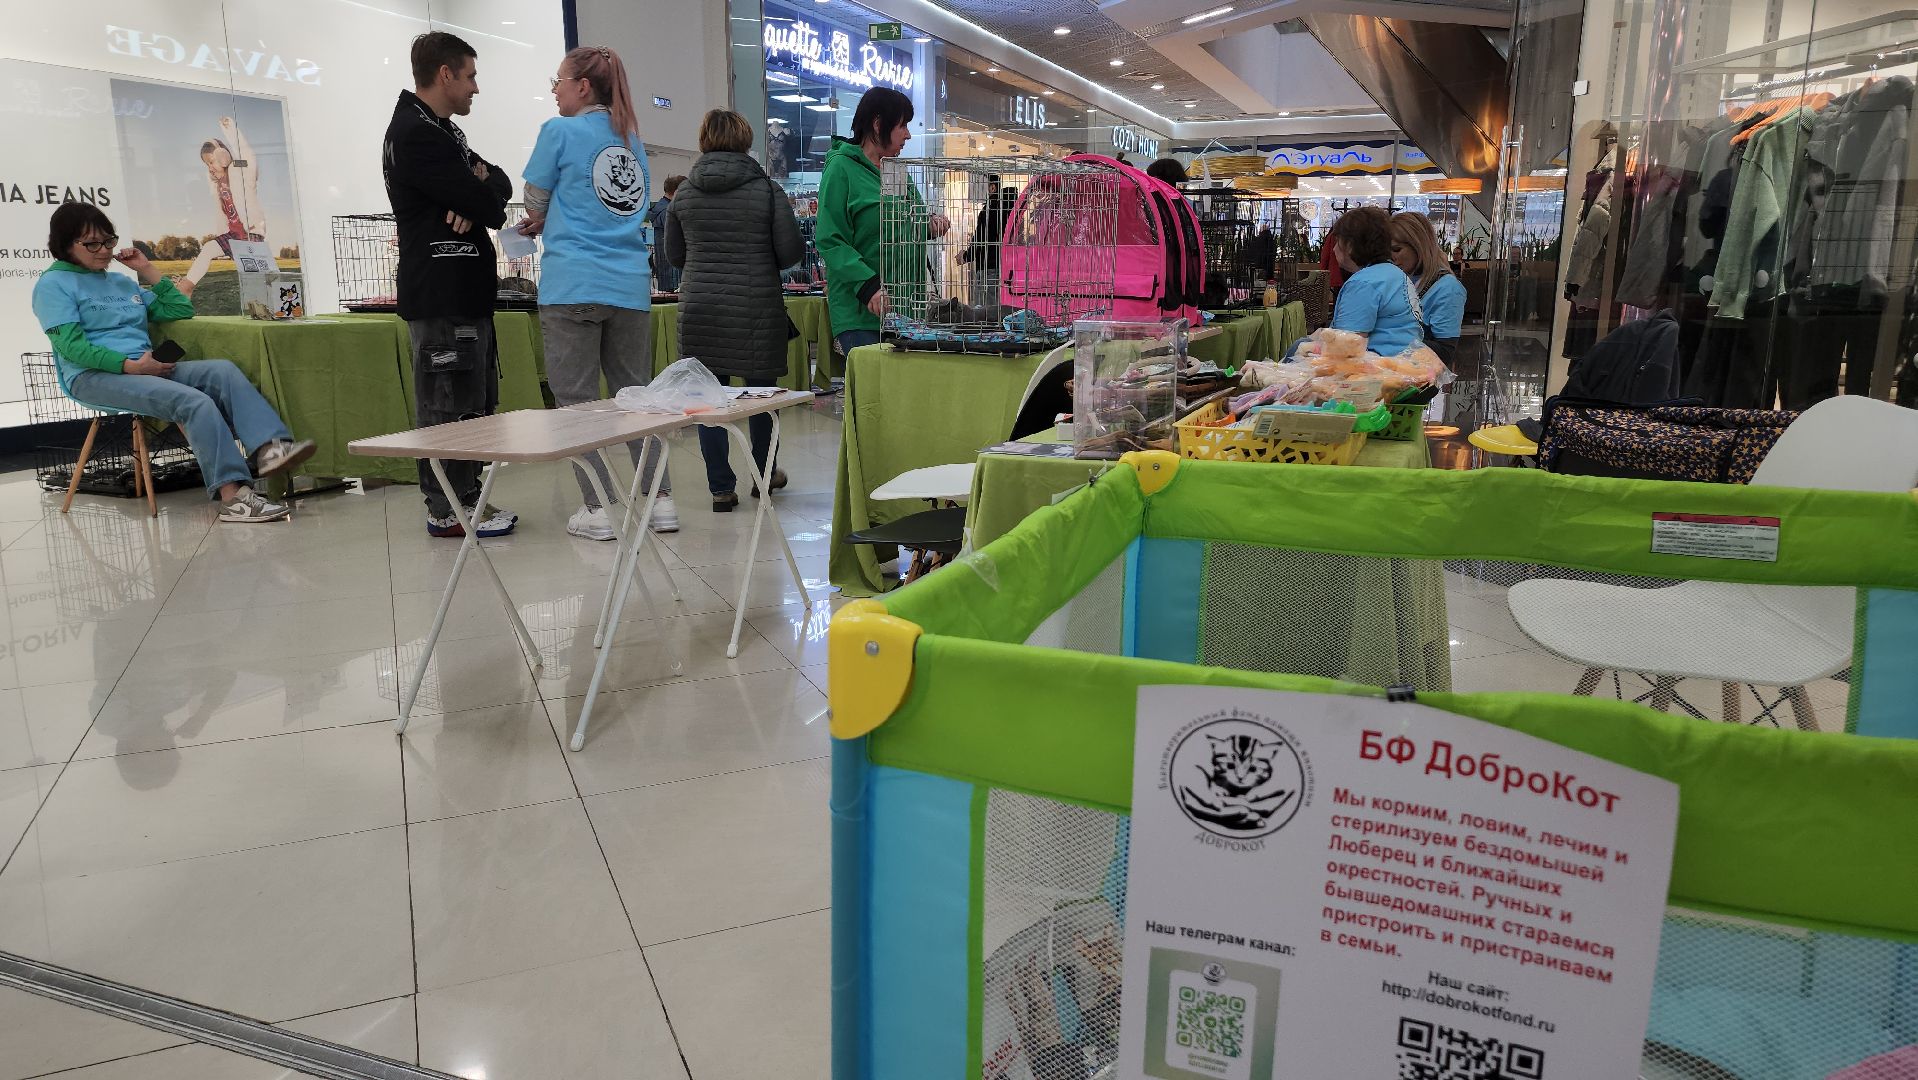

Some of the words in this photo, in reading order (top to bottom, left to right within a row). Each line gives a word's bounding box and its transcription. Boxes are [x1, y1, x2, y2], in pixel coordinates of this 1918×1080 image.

[1113, 126, 1136, 152] COZY
[1138, 135, 1159, 160] HOME
[35, 184, 111, 207] JEANS
[14, 248, 57, 260] колл
[1360, 729, 1416, 764] БФ
[1425, 740, 1621, 814] ДоброКот
[1331, 814, 1458, 848] стерилизуем
[1463, 835, 1604, 882] бездомышей
[1333, 787, 1367, 807] Мы
[1371, 796, 1453, 825] кормим,
[1459, 812, 1532, 843] ловим,
[1539, 831, 1608, 860] лечим
[1614, 849, 1629, 865] и
[1326, 861, 1465, 899] окрестностей.
[1472, 886, 1553, 919] Ручных
[1559, 910, 1573, 924] и
[1328, 834, 1417, 867] Люберец
[1423, 855, 1435, 868] и
[1441, 855, 1562, 897] ближайших
[1146, 920, 1176, 936] Наш
[1180, 926, 1246, 945] телеграм
[1249, 938, 1297, 957] канал:
[1320, 928, 1332, 943] в
[1337, 934, 1404, 958] семьи.
[1322, 905, 1437, 941] пристроить
[1442, 929, 1455, 944] и
[1460, 934, 1614, 984] пристраиваем
[1324, 880, 1497, 931] бывшедомашних
[1501, 919, 1616, 960] стараемся
[1382, 980, 1557, 1034] http://dobrokotfond.ru
[1428, 970, 1464, 990] Наш
[1467, 981, 1510, 1002] сайт:
